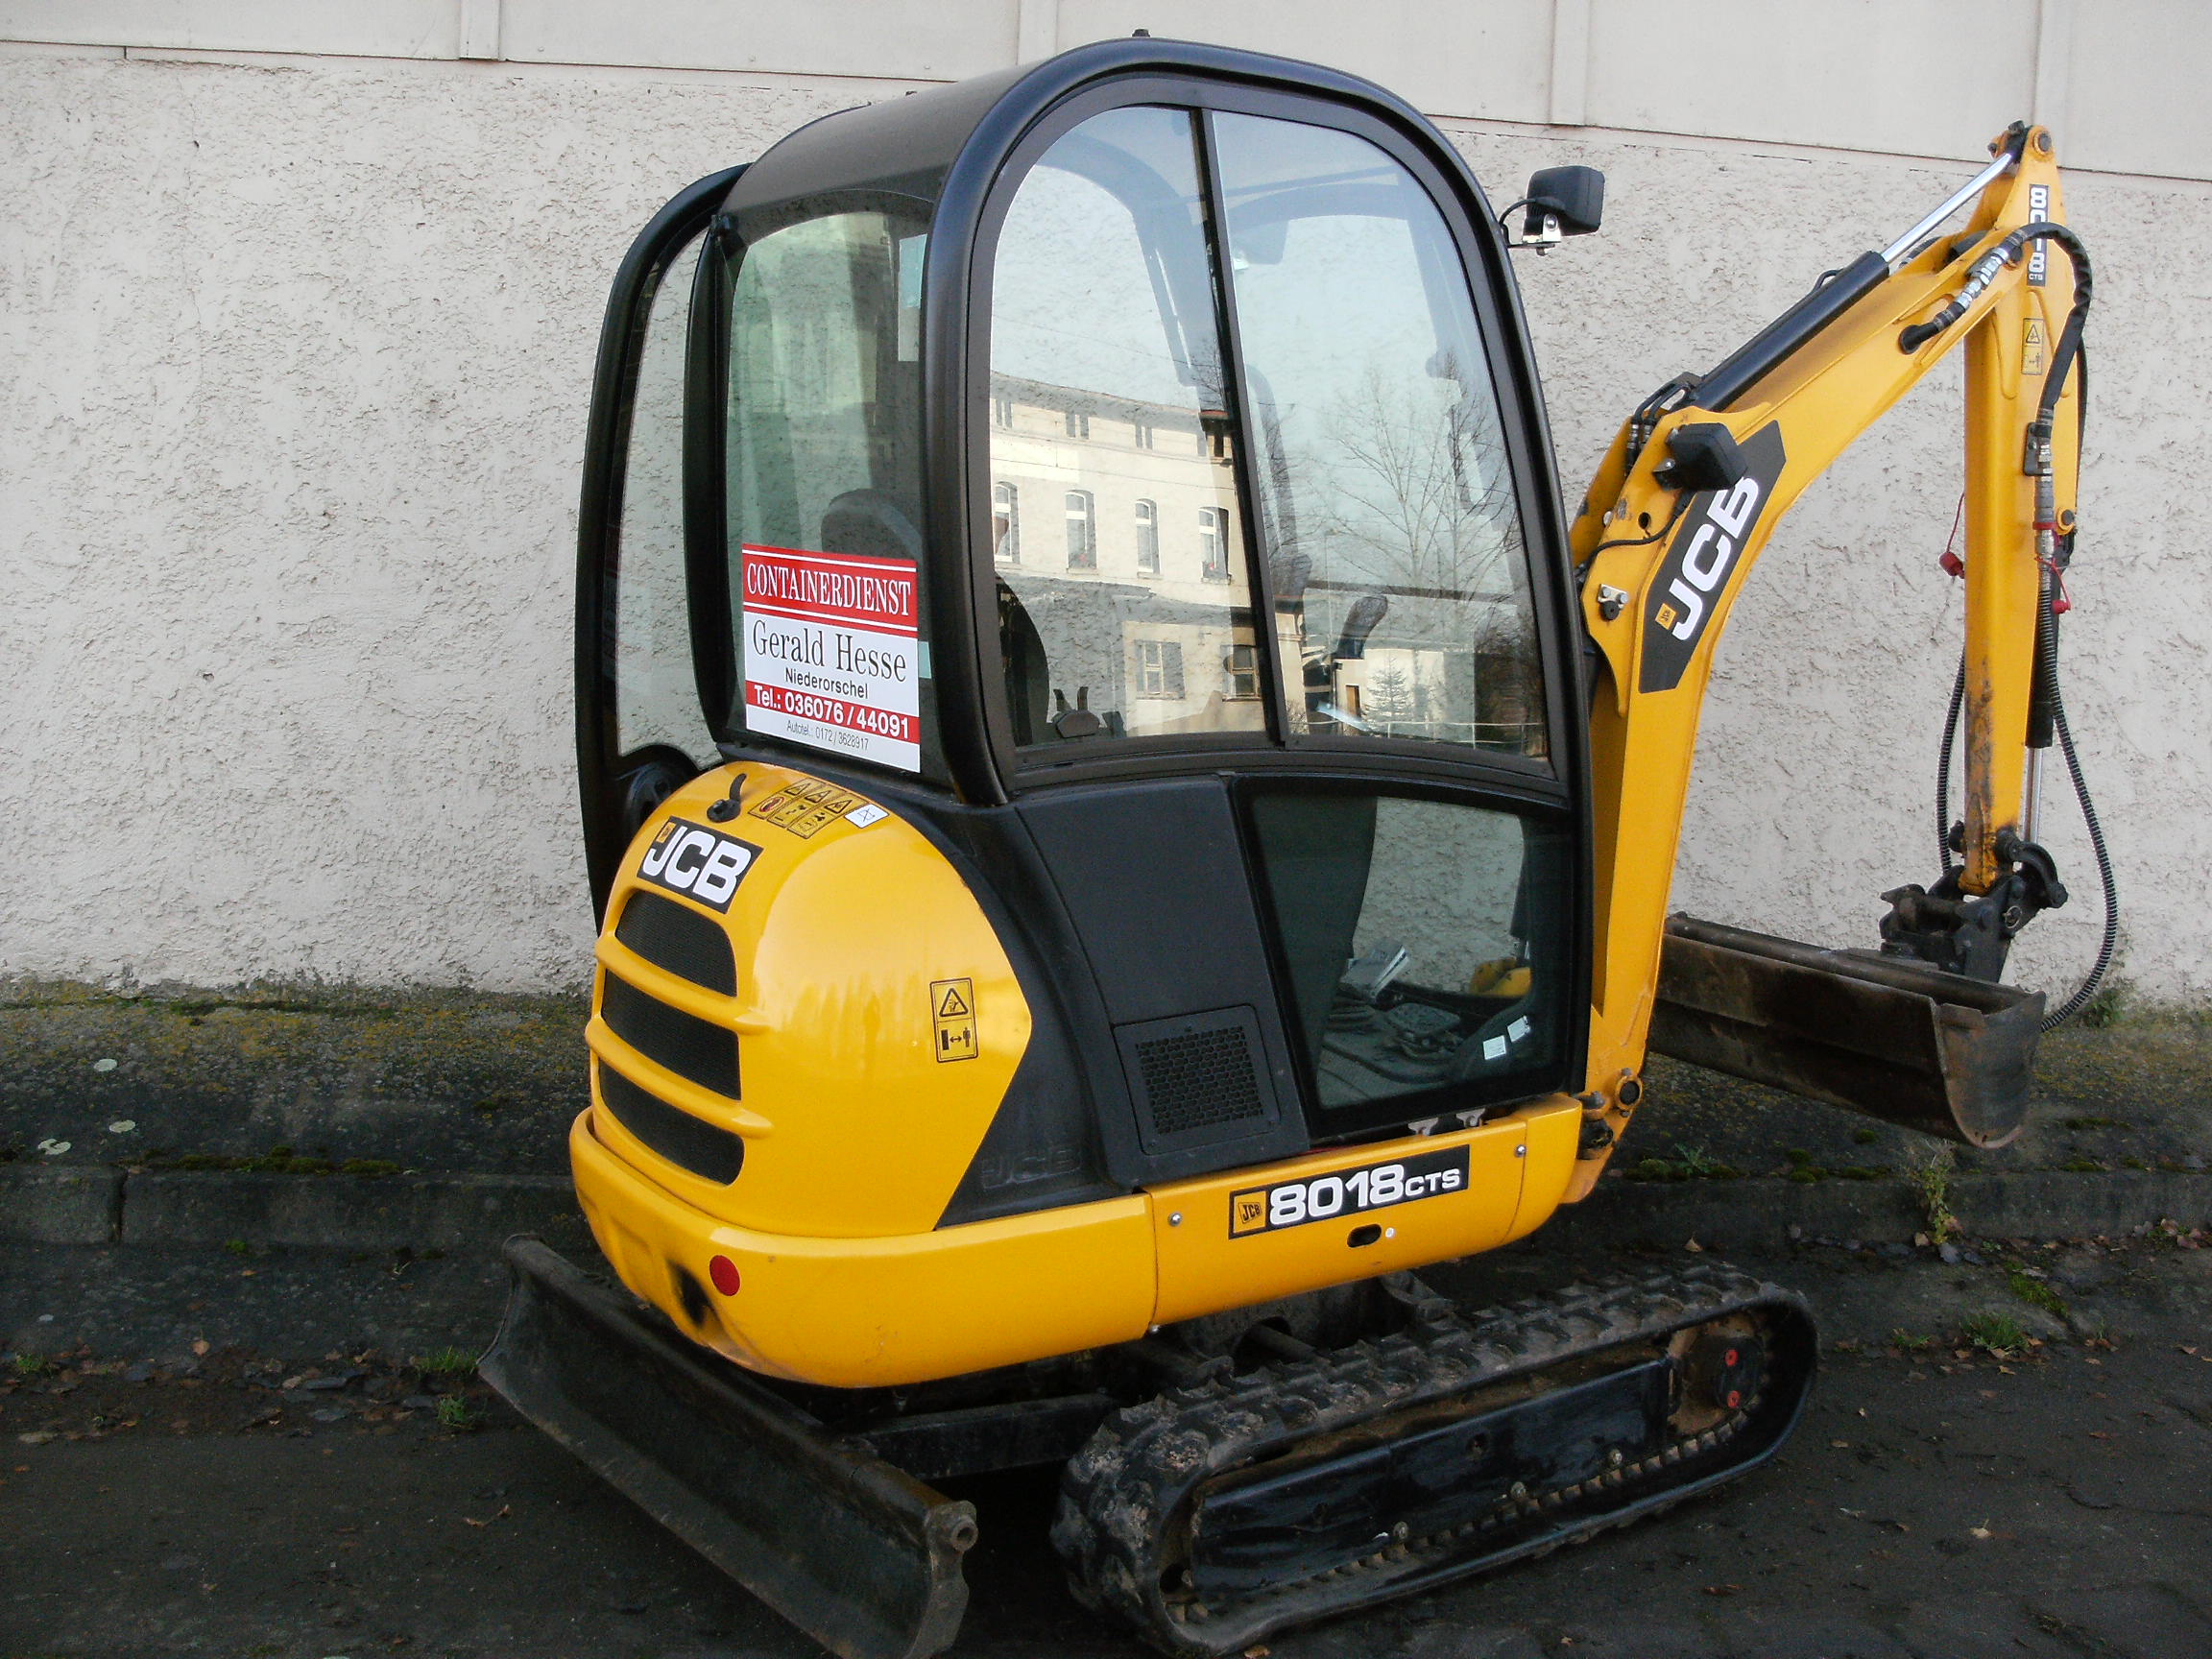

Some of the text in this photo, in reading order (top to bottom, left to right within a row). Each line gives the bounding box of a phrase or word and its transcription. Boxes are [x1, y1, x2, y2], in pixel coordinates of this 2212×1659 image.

[1669, 476, 1759, 640] JCB
[747, 563, 911, 616] CONTAINERDIENST
[753, 619, 907, 683] Gerald Hesse
[785, 667, 868, 699] Niederorschel
[754, 685, 781, 709] Tel.:
[784, 691, 844, 724] 036076
[856, 709, 909, 738] 44091
[642, 826, 752, 904] JCB
[1241, 1202, 1262, 1222] JCB
